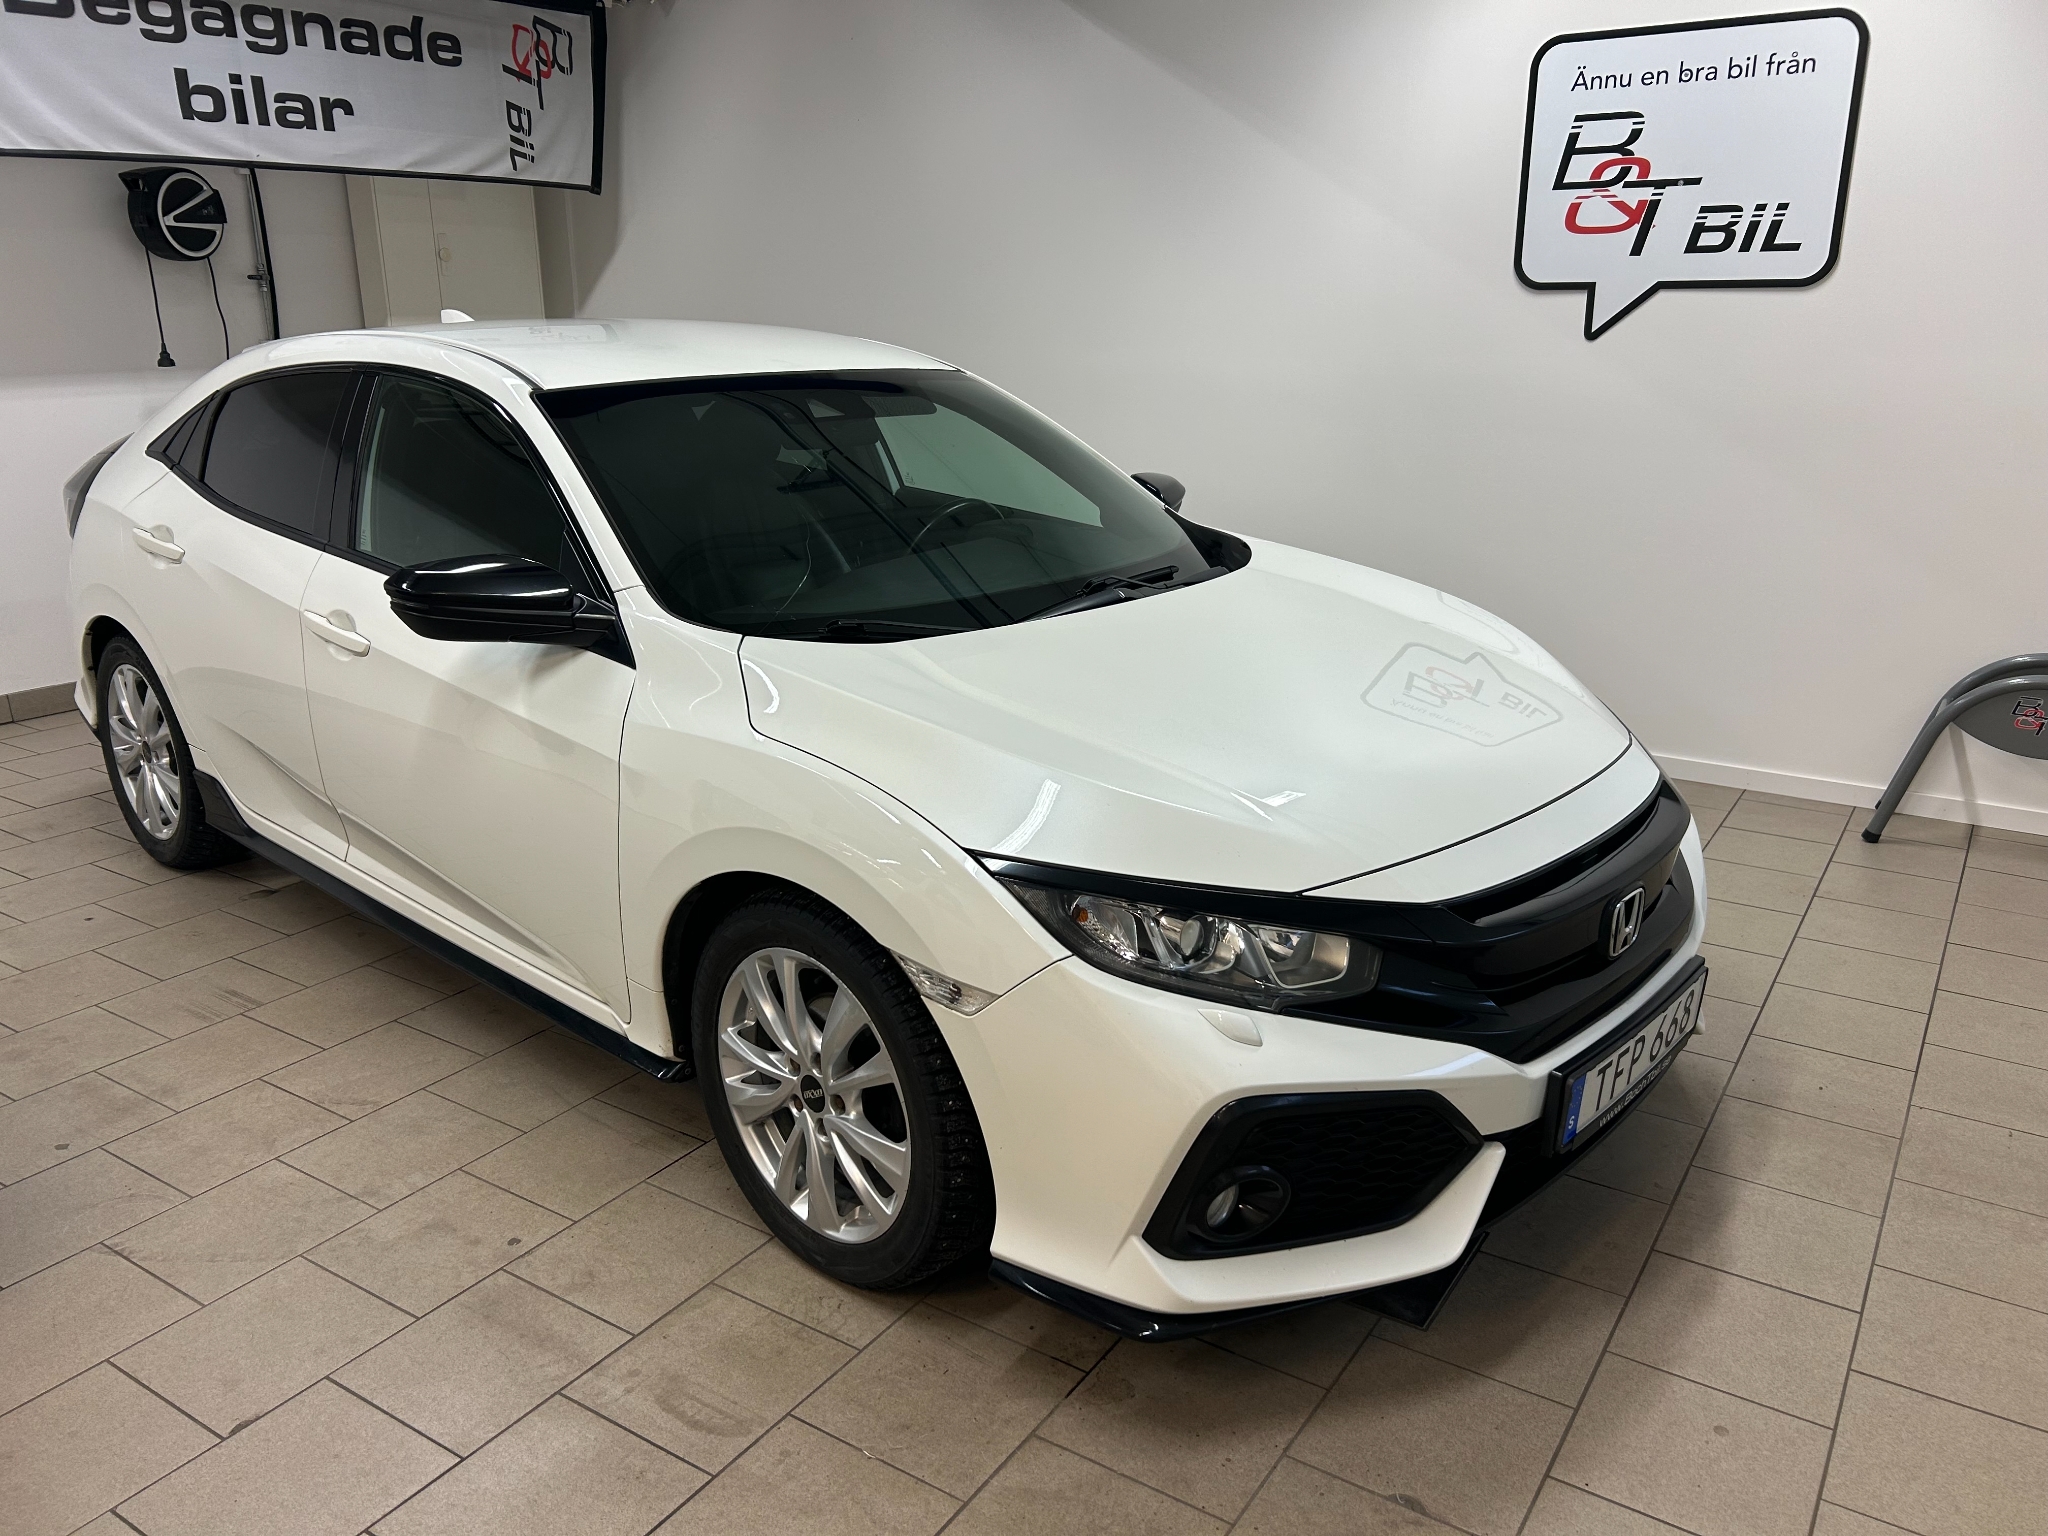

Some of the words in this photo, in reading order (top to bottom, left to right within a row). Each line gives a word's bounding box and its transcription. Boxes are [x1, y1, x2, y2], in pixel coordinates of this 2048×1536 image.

[1571, 65, 1632, 91] Ännu
[1641, 69, 1669, 86] en
[1678, 60, 1718, 83] bra
[1727, 54, 1758, 79] bil
[1765, 51, 1817, 76] från
[173, 67, 354, 132] bilar
[1683, 202, 1802, 254] BIL
[1595, 1035, 1645, 1112] TFP
[1650, 989, 1695, 1062] 668
[1569, 1115, 1575, 1129] S
